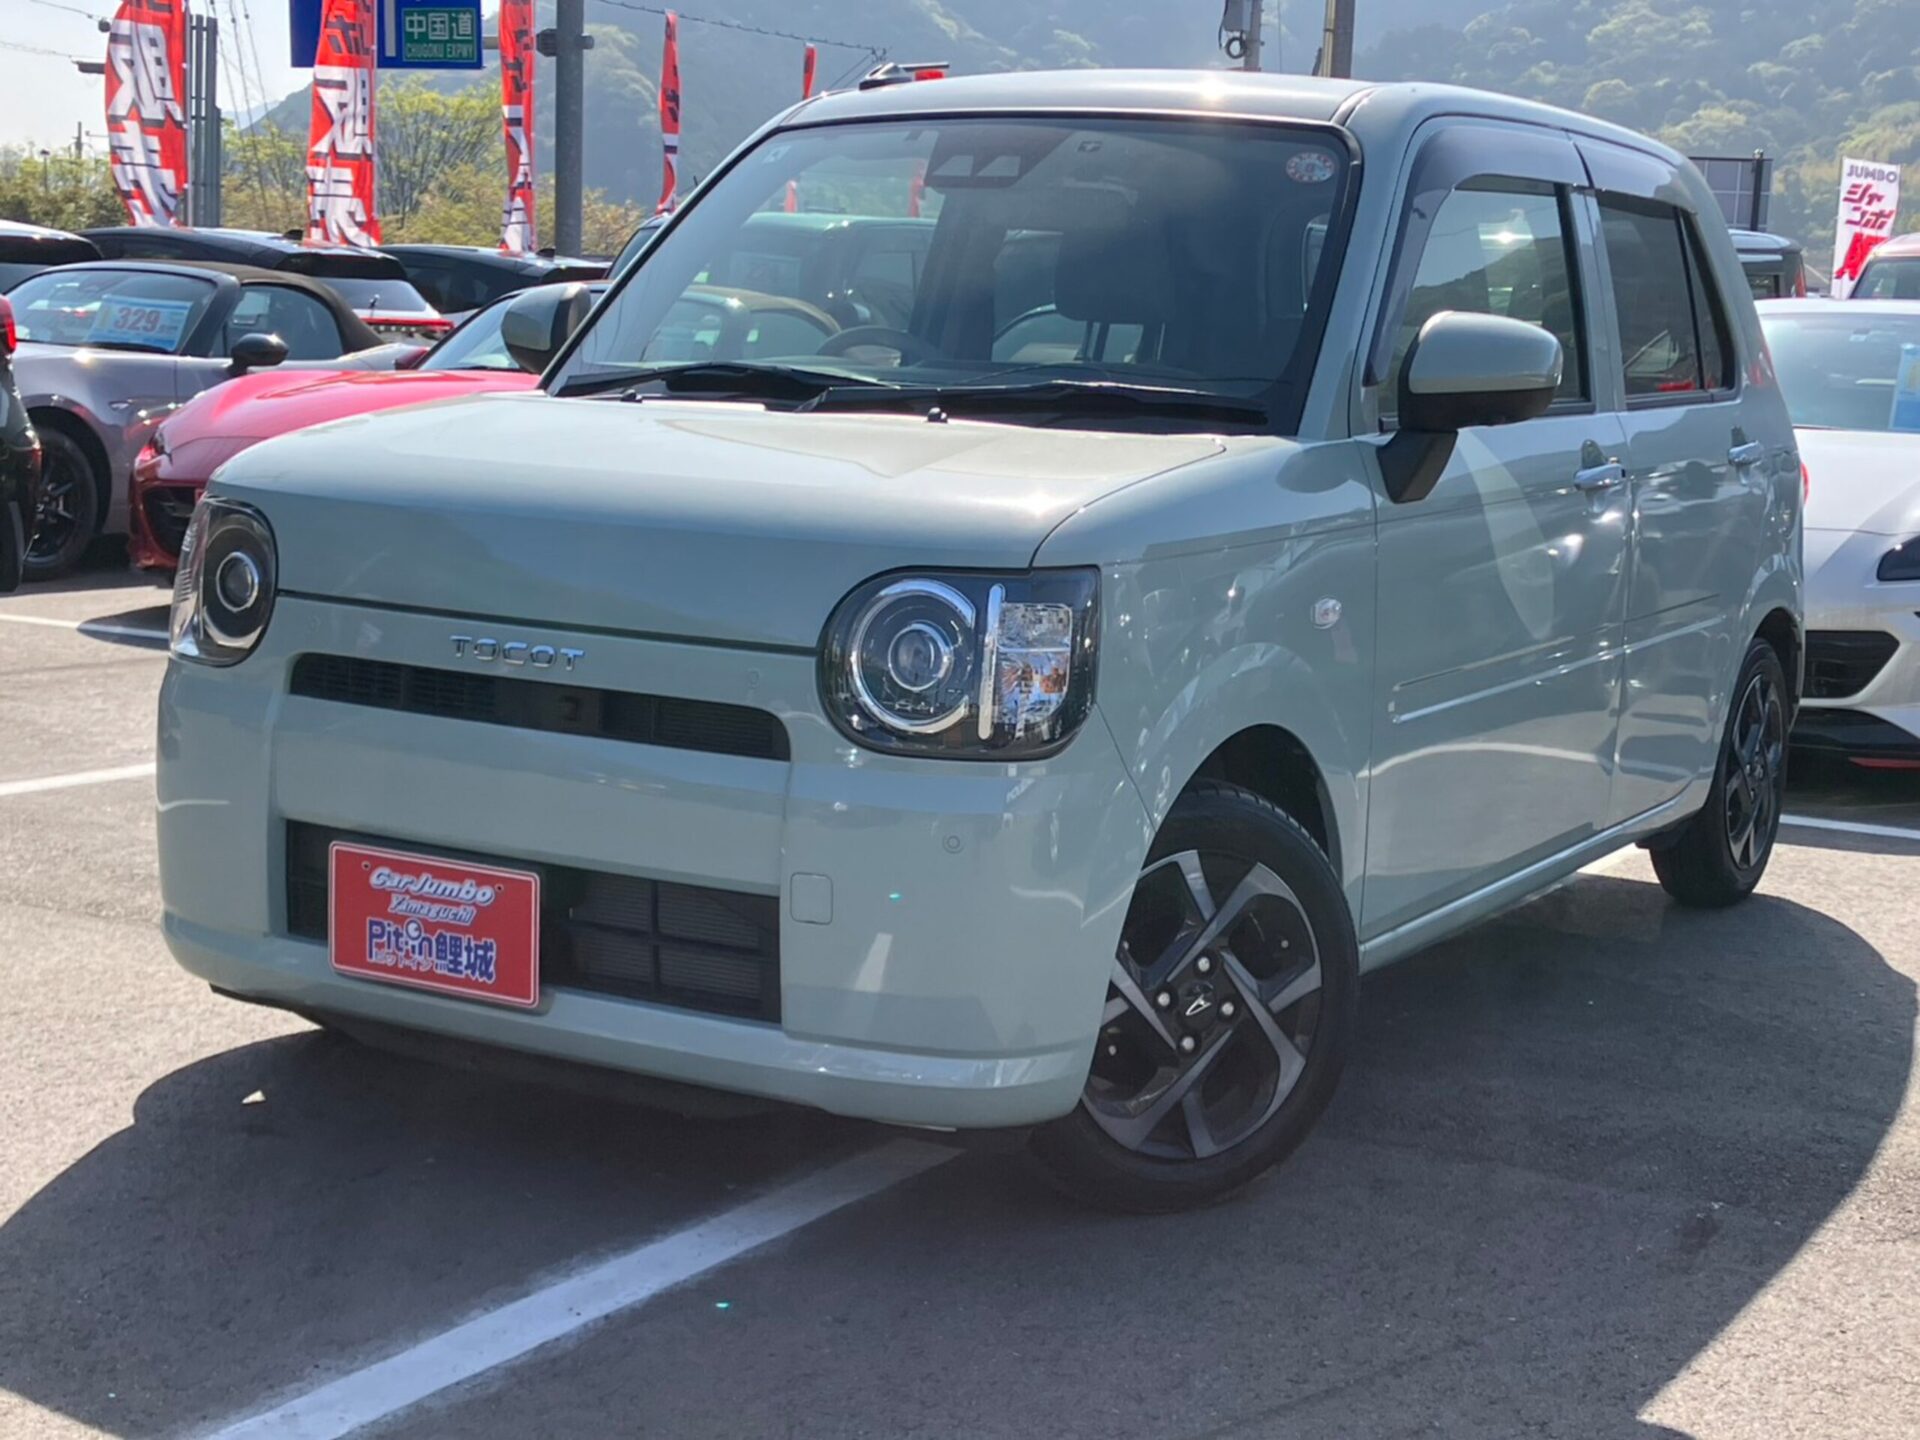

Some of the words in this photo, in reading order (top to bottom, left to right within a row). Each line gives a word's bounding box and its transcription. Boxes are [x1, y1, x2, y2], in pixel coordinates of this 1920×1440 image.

[405, 12, 473, 40] 中国道
[1846, 164, 1898, 183] JUMBO
[113, 306, 161, 333] 329
[450, 635, 586, 671] TOCOT
